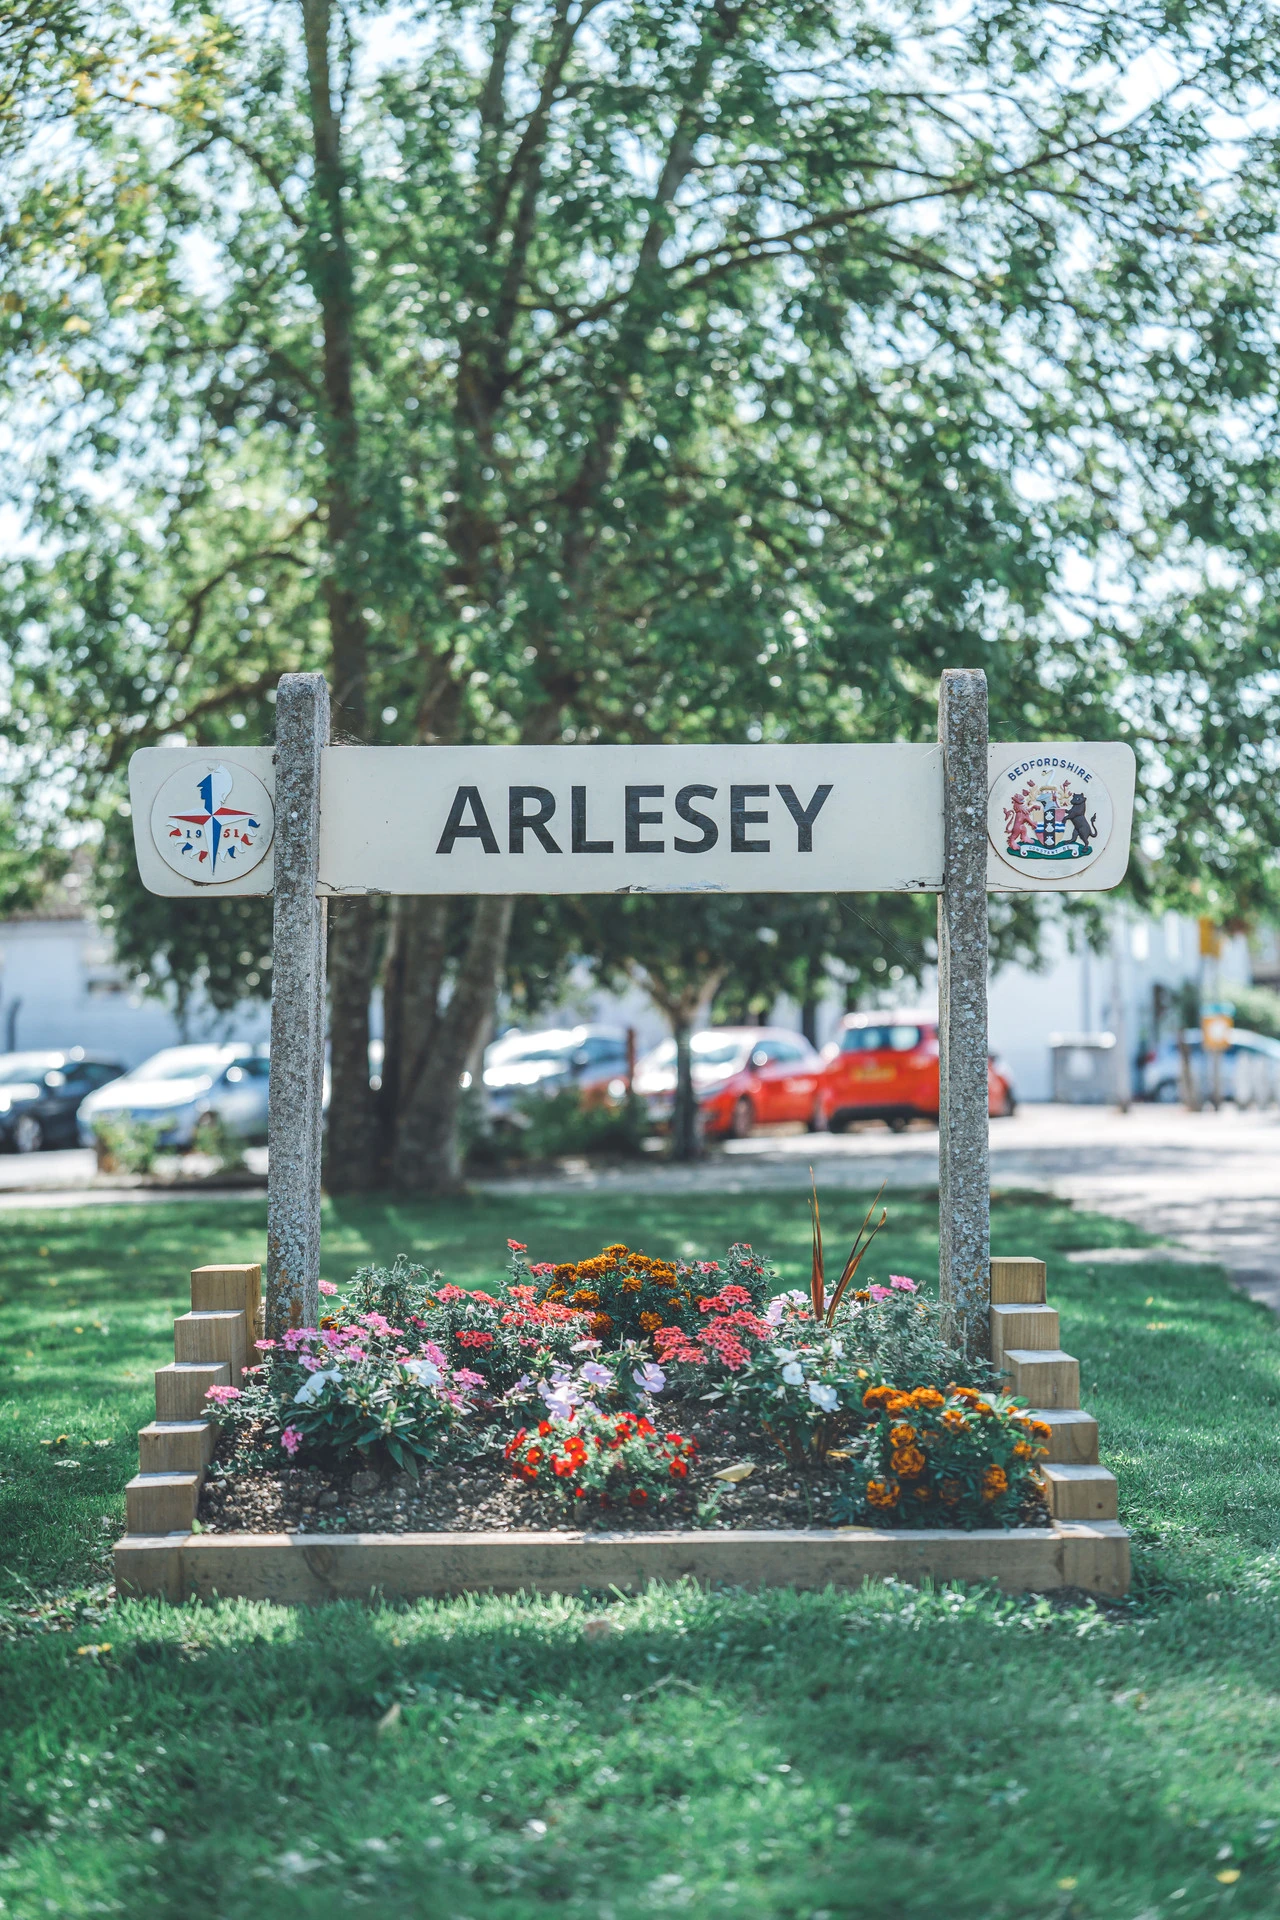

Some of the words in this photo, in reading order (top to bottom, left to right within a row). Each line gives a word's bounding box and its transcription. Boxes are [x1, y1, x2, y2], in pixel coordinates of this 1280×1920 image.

[1007, 757, 1093, 783] BEDFORDSHIRE
[436, 784, 834, 854] ARLESEY
[186, 829, 202, 838] 19
[223, 828, 240, 838] 51
